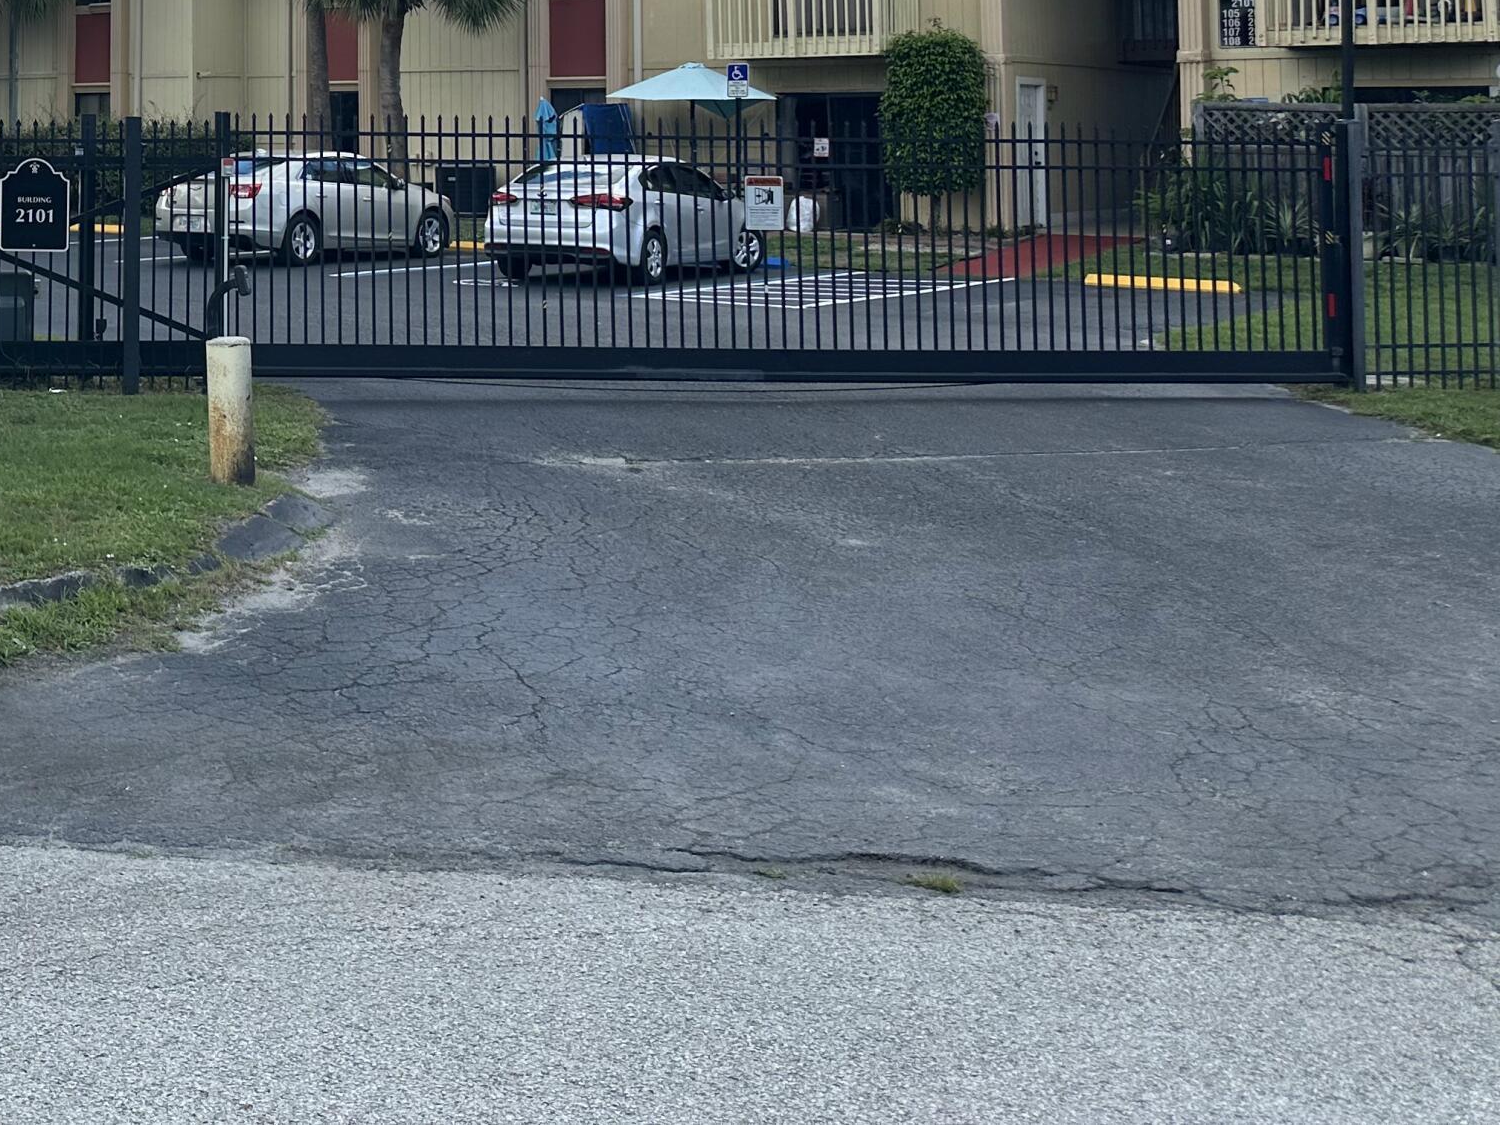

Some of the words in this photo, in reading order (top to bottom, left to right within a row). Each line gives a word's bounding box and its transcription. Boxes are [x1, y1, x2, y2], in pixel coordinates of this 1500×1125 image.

[1222, 9, 1240, 18] 105
[1222, 18, 1241, 27] 106
[1223, 28, 1240, 36] 107
[1223, 37, 1241, 45] 108
[15, 208, 54, 223] 2101
